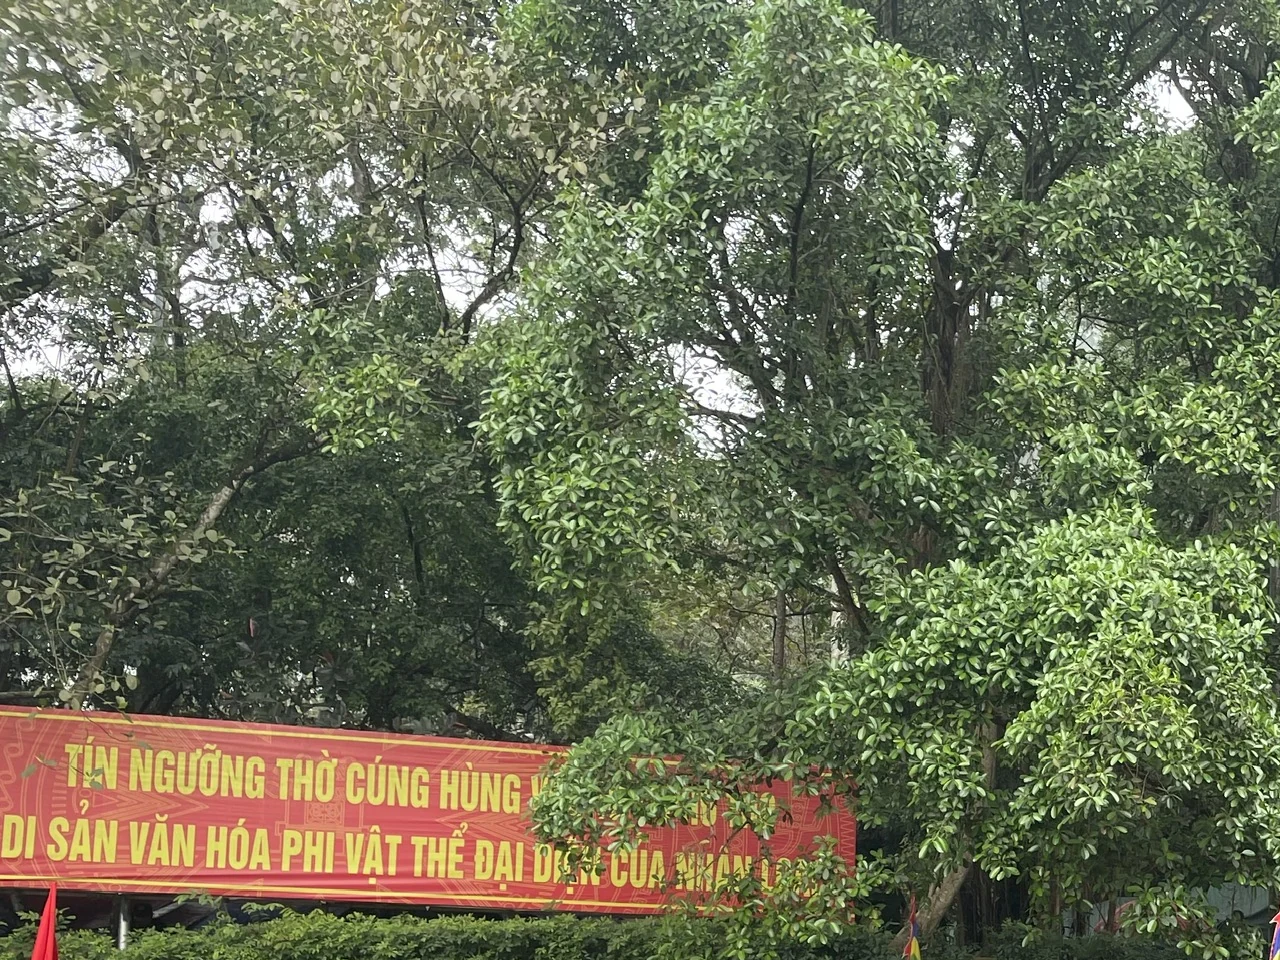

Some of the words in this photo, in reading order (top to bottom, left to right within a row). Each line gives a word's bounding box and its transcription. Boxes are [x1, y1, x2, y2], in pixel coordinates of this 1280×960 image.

[64, 736, 119, 790] TÍN
[129, 743, 266, 800] NGƯỠNG
[276, 749, 338, 803] THỜ
[345, 755, 430, 809] CÚNG
[439, 761, 521, 814] HÙNG
[1, 815, 37, 860] DI
[47, 799, 118, 863] SẢN
[129, 814, 196, 868] VĂN
[205, 818, 272, 871] HÓA
[281, 829, 335, 874] PHI
[345, 824, 403, 885] VẬT
[411, 821, 468, 881] THỂ
[474, 837, 525, 892] ĐẠI
